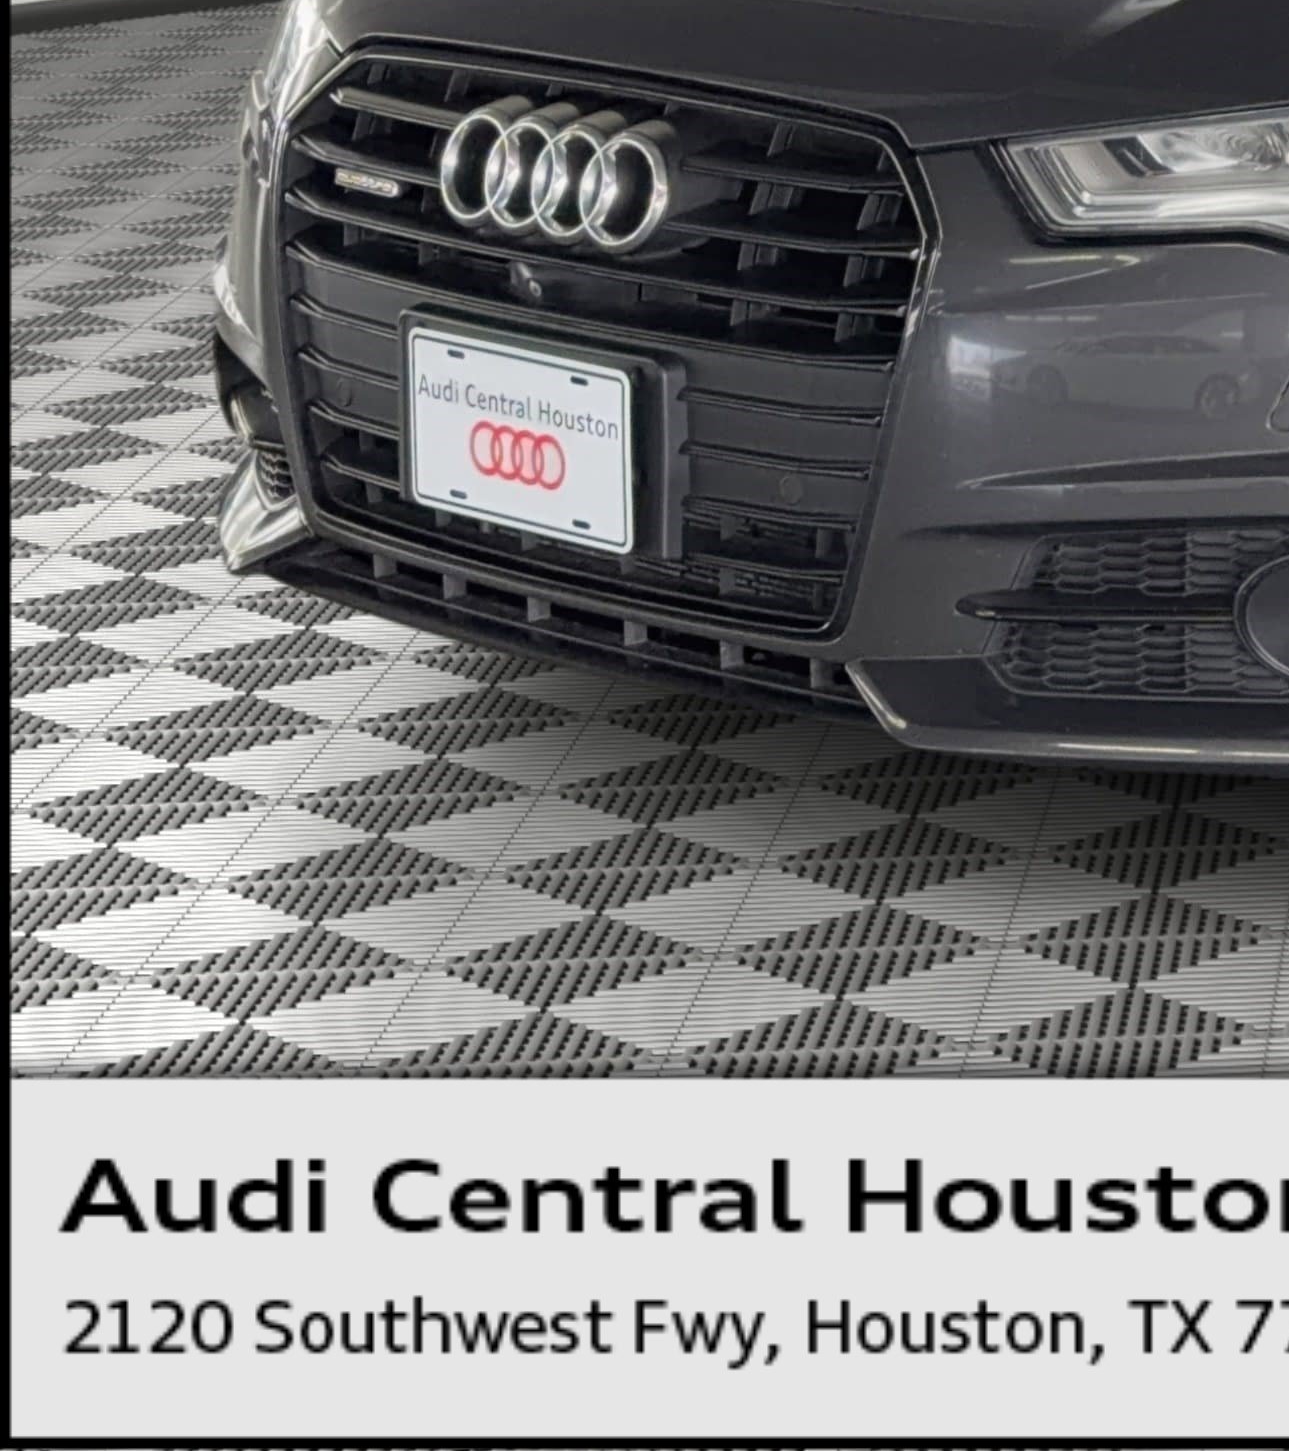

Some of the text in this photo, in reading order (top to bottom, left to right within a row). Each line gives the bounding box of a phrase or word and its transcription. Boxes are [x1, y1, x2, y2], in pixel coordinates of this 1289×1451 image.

[418, 373, 619, 441] Audi Central Houston
